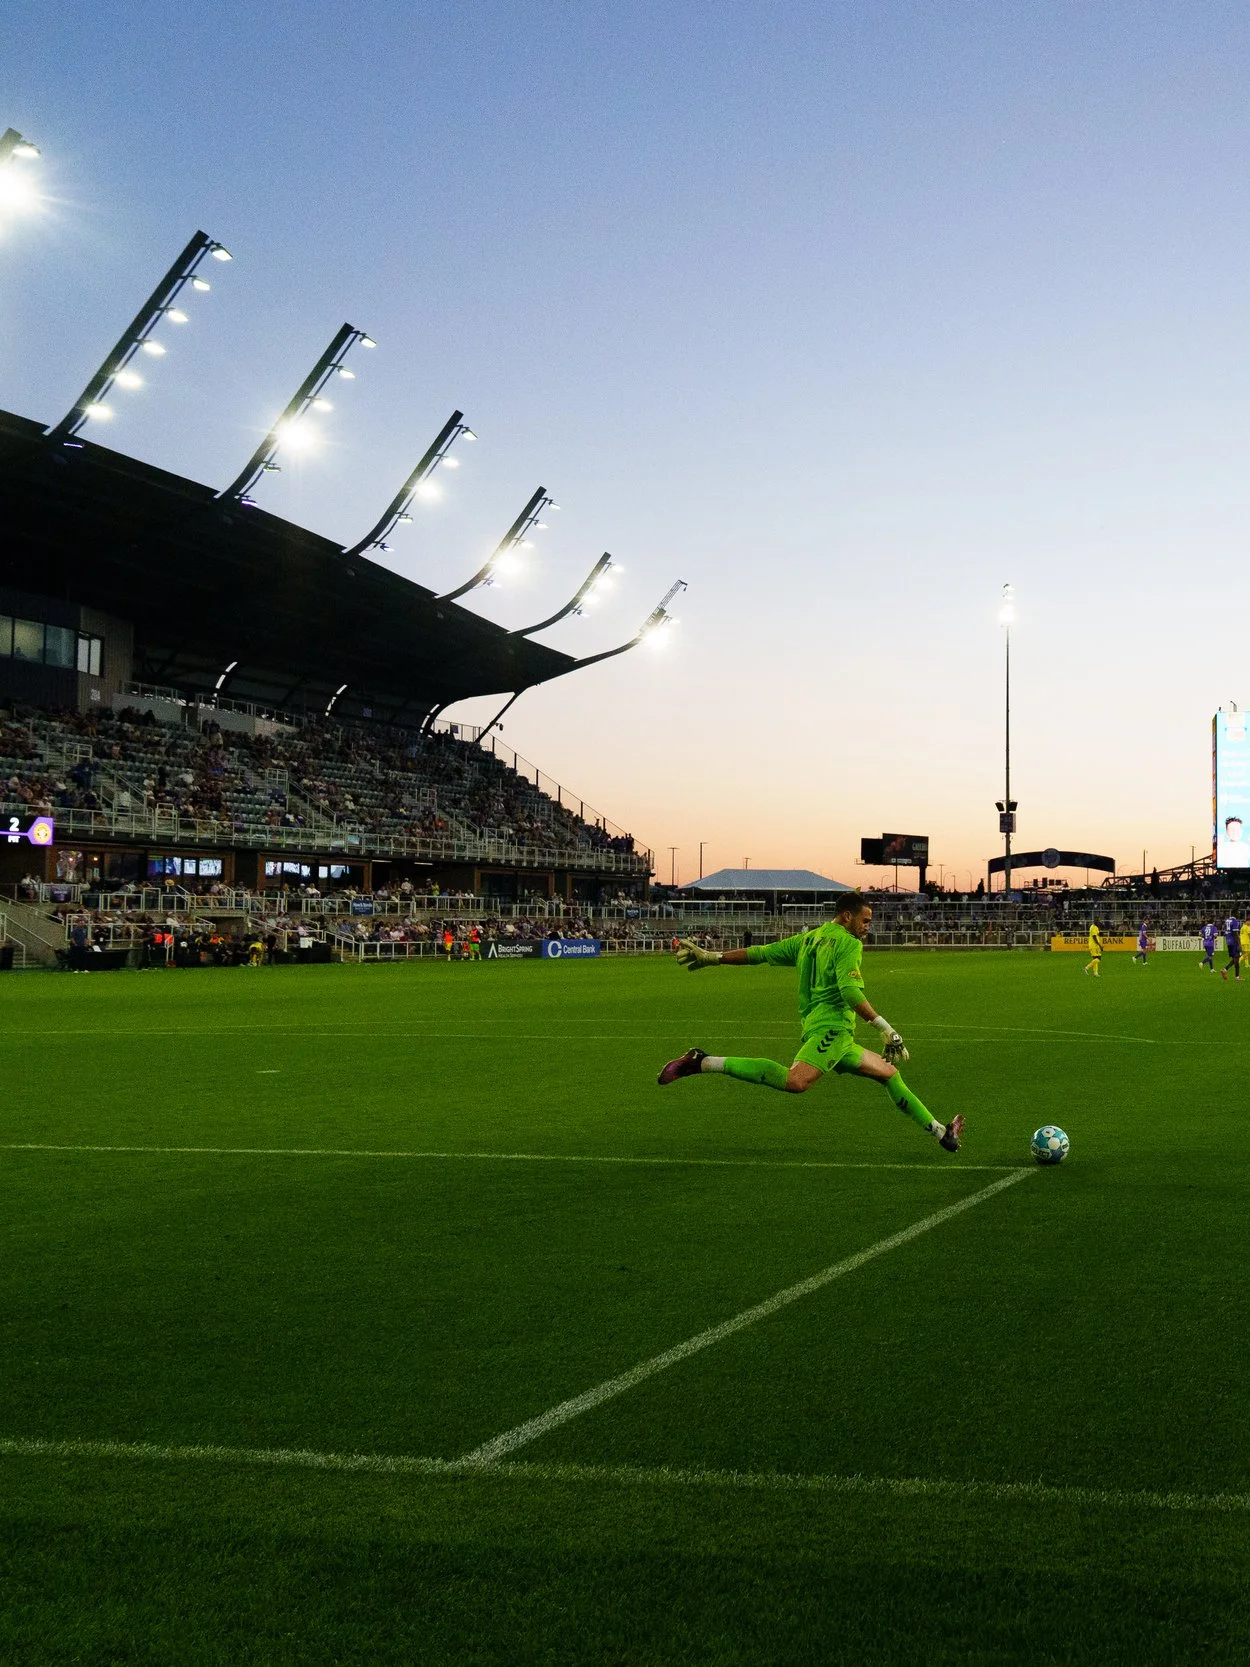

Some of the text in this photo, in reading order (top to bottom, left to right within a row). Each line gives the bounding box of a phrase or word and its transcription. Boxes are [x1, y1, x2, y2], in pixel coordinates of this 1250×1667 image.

[9, 817, 20, 831] 2
[563, 945, 582, 954] Central
[582, 945, 596, 954] Bank
[1162, 939, 1190, 950] BUFFALO
